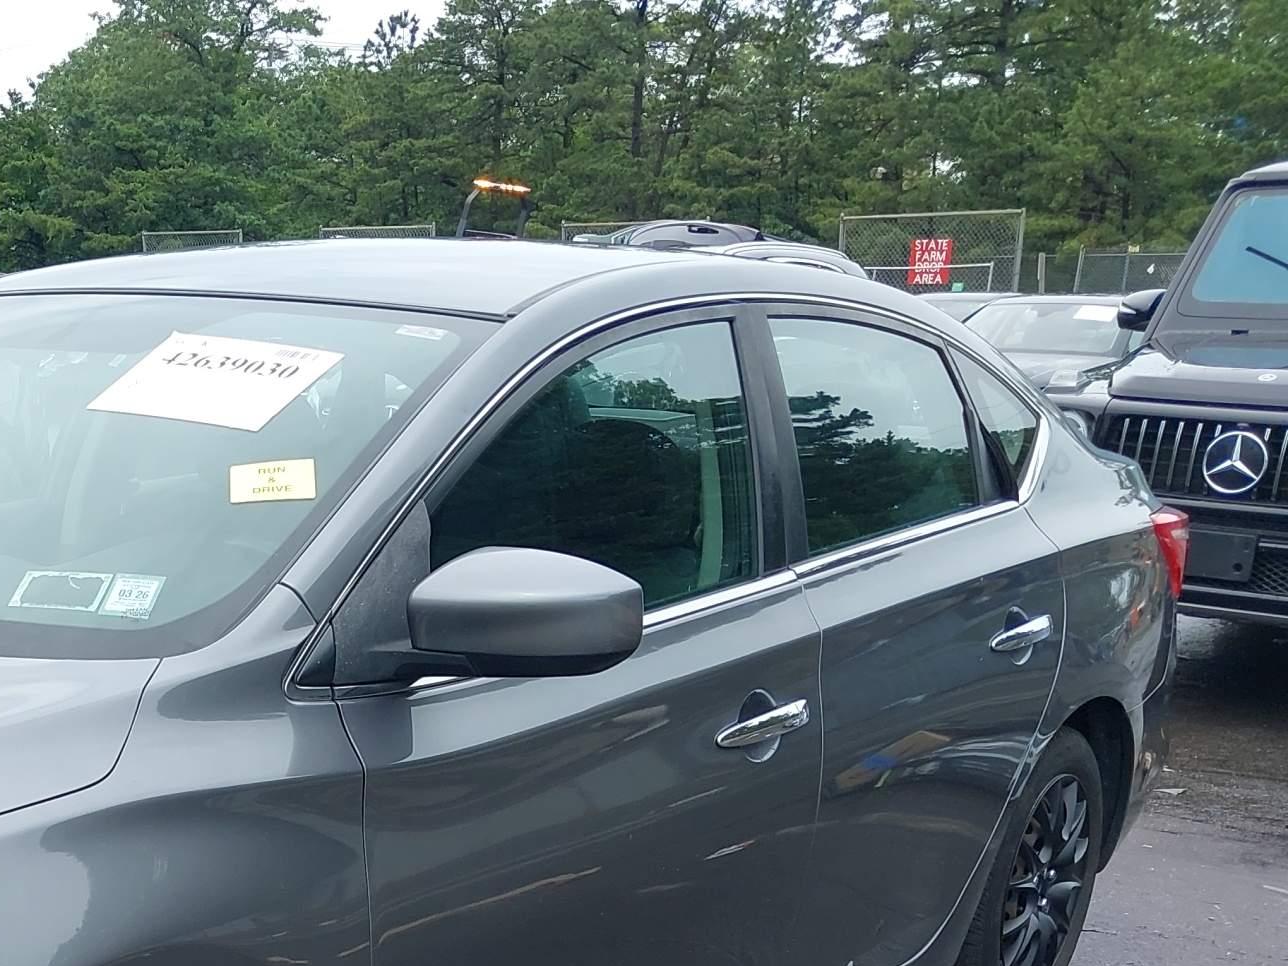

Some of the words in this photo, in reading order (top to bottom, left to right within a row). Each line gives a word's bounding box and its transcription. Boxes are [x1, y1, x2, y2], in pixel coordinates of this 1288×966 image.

[915, 239, 949, 251] STATE
[915, 251, 947, 262] FARM
[914, 262, 945, 273] DROP
[912, 273, 943, 285] AREA
[161, 350, 300, 379] 42639030
[257, 465, 287, 475] RUN
[252, 484, 293, 495] DRIVE
[118, 588, 133, 599] 03
[135, 590, 151, 600] 26
